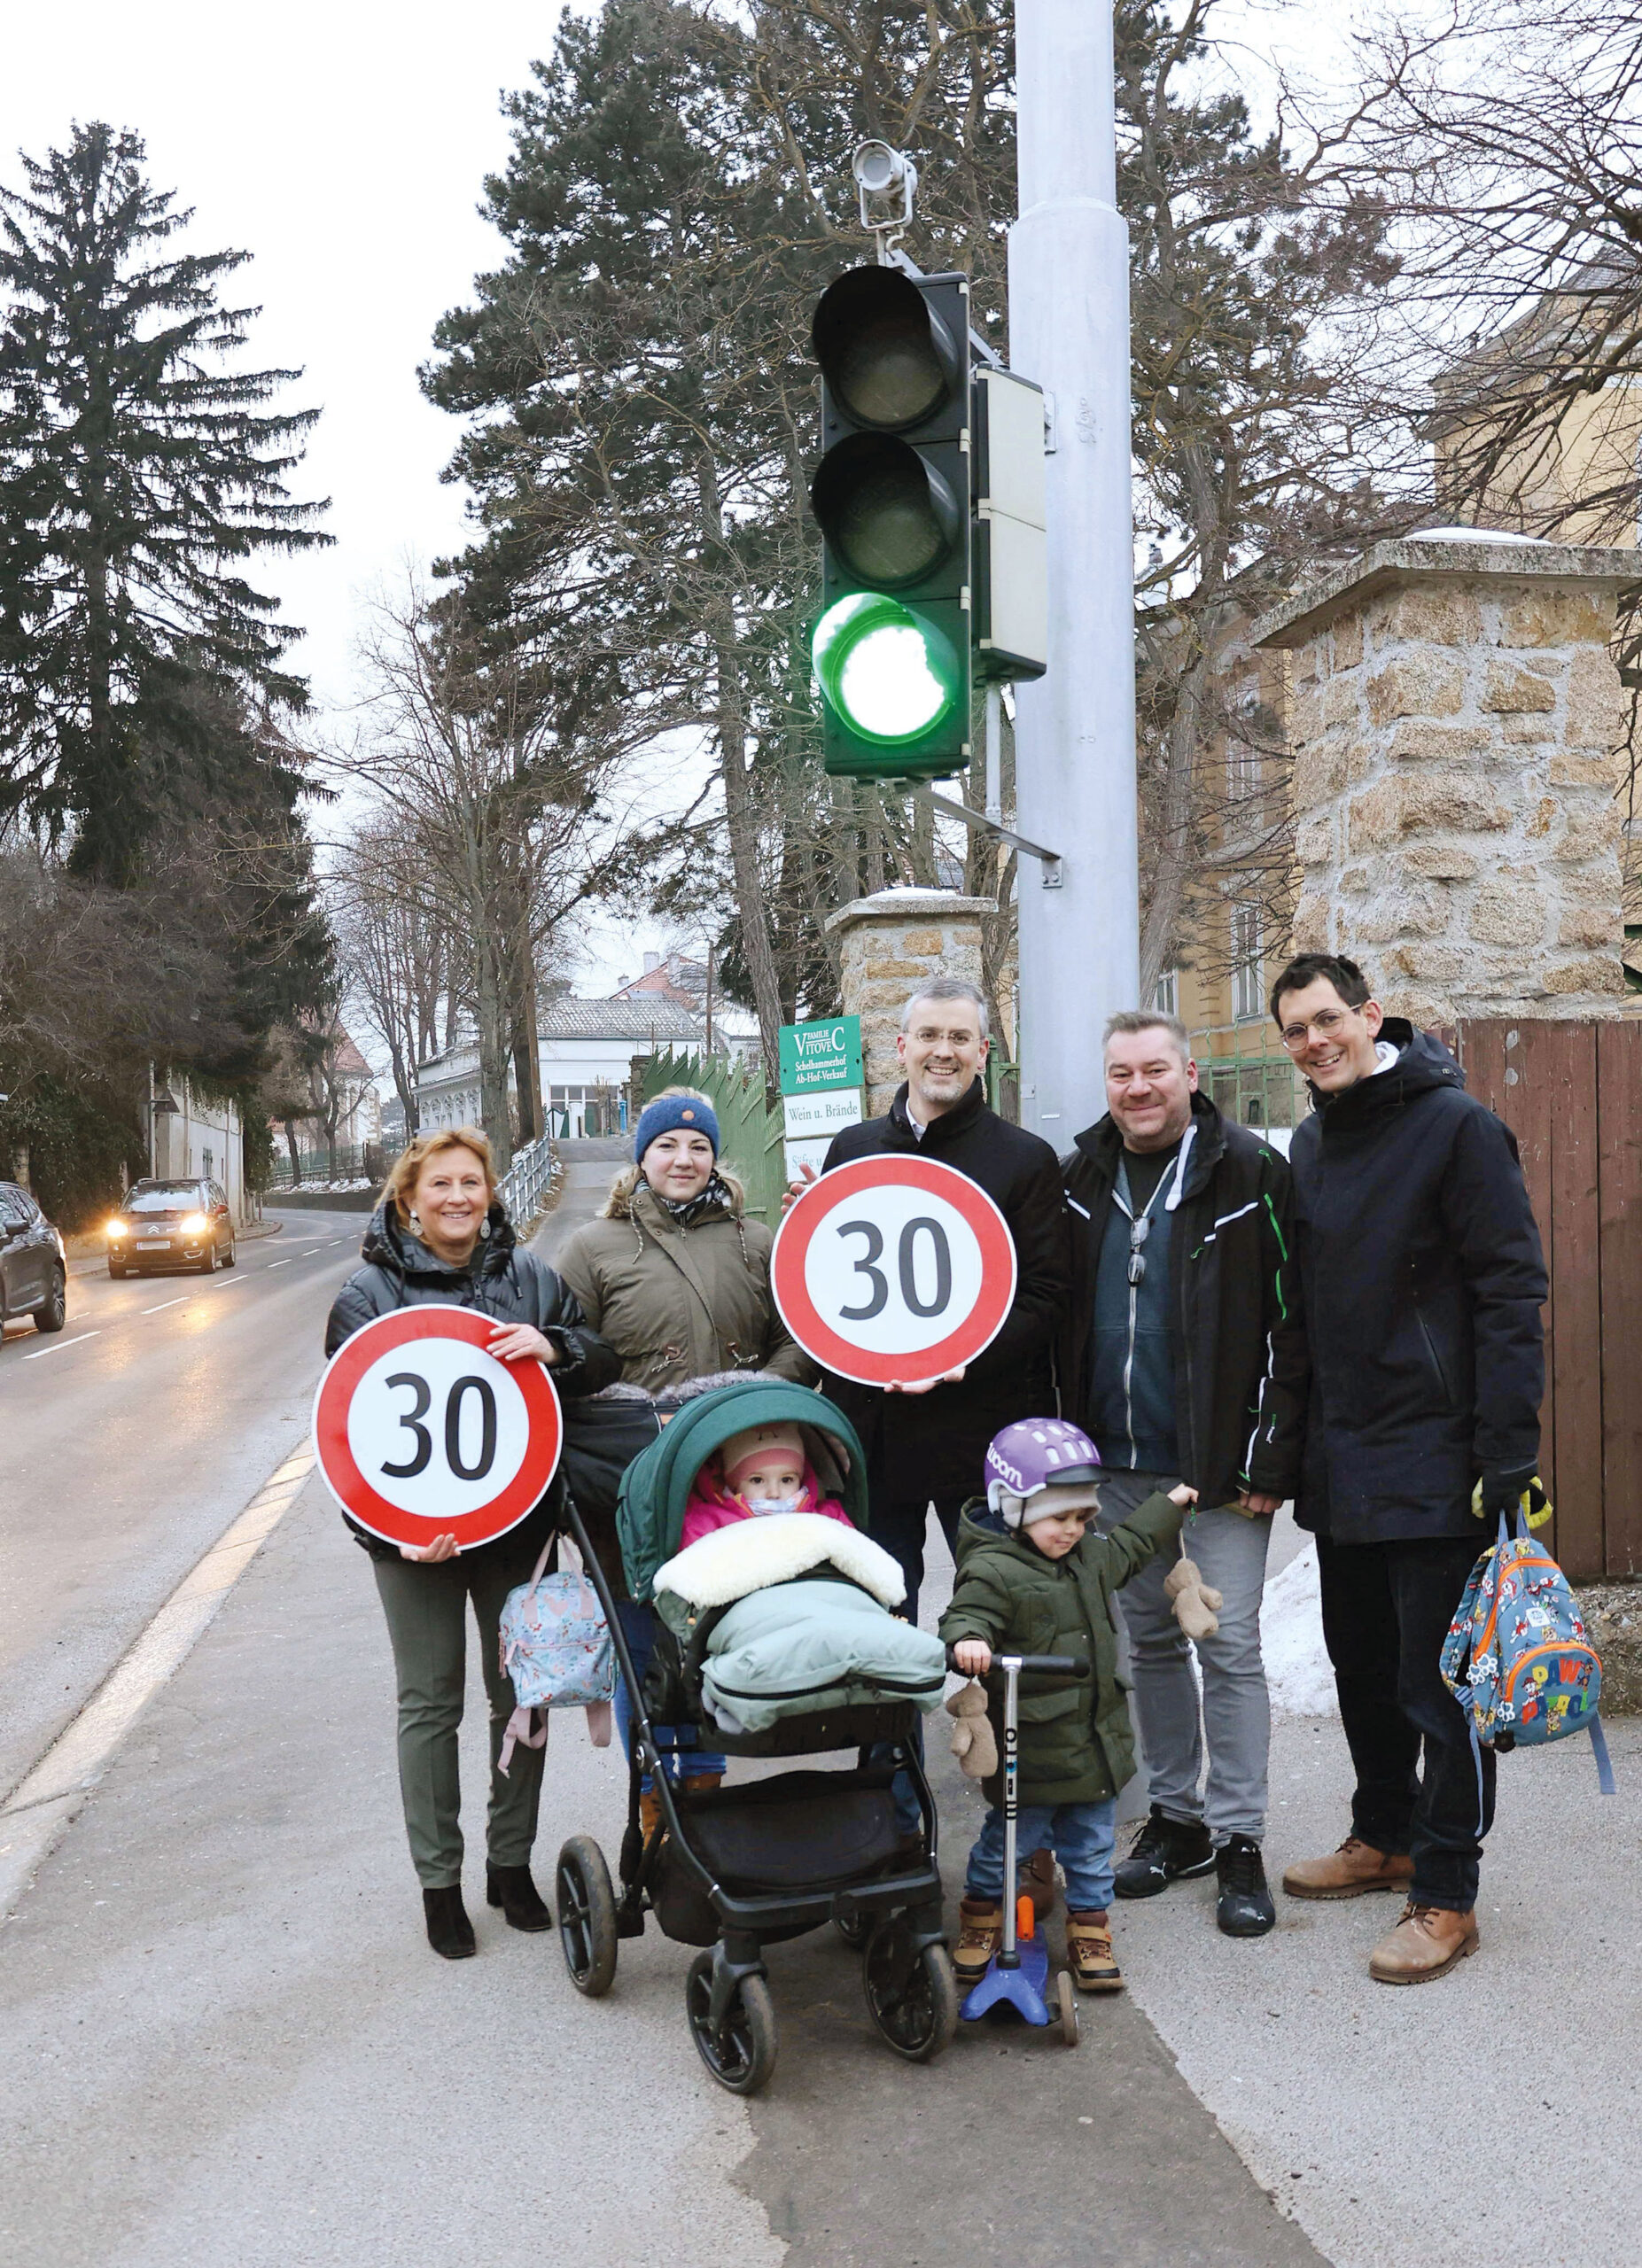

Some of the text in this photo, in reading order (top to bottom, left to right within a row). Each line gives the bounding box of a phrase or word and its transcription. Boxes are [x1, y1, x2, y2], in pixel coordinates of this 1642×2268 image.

[793, 1026, 845, 1057] VITOVEC
[807, 1029, 829, 1040] FAMILIE
[795, 1053, 847, 1072] Schelhammerhof
[795, 1067, 848, 1084] Ab-Hof-Verkauf
[789, 1100, 858, 1121] Wein u. Brände
[836, 1216, 952, 1320] 30
[380, 1372, 497, 1480] 30
[986, 1441, 1023, 1489] woom
[1531, 1658, 1582, 1690] PAW
